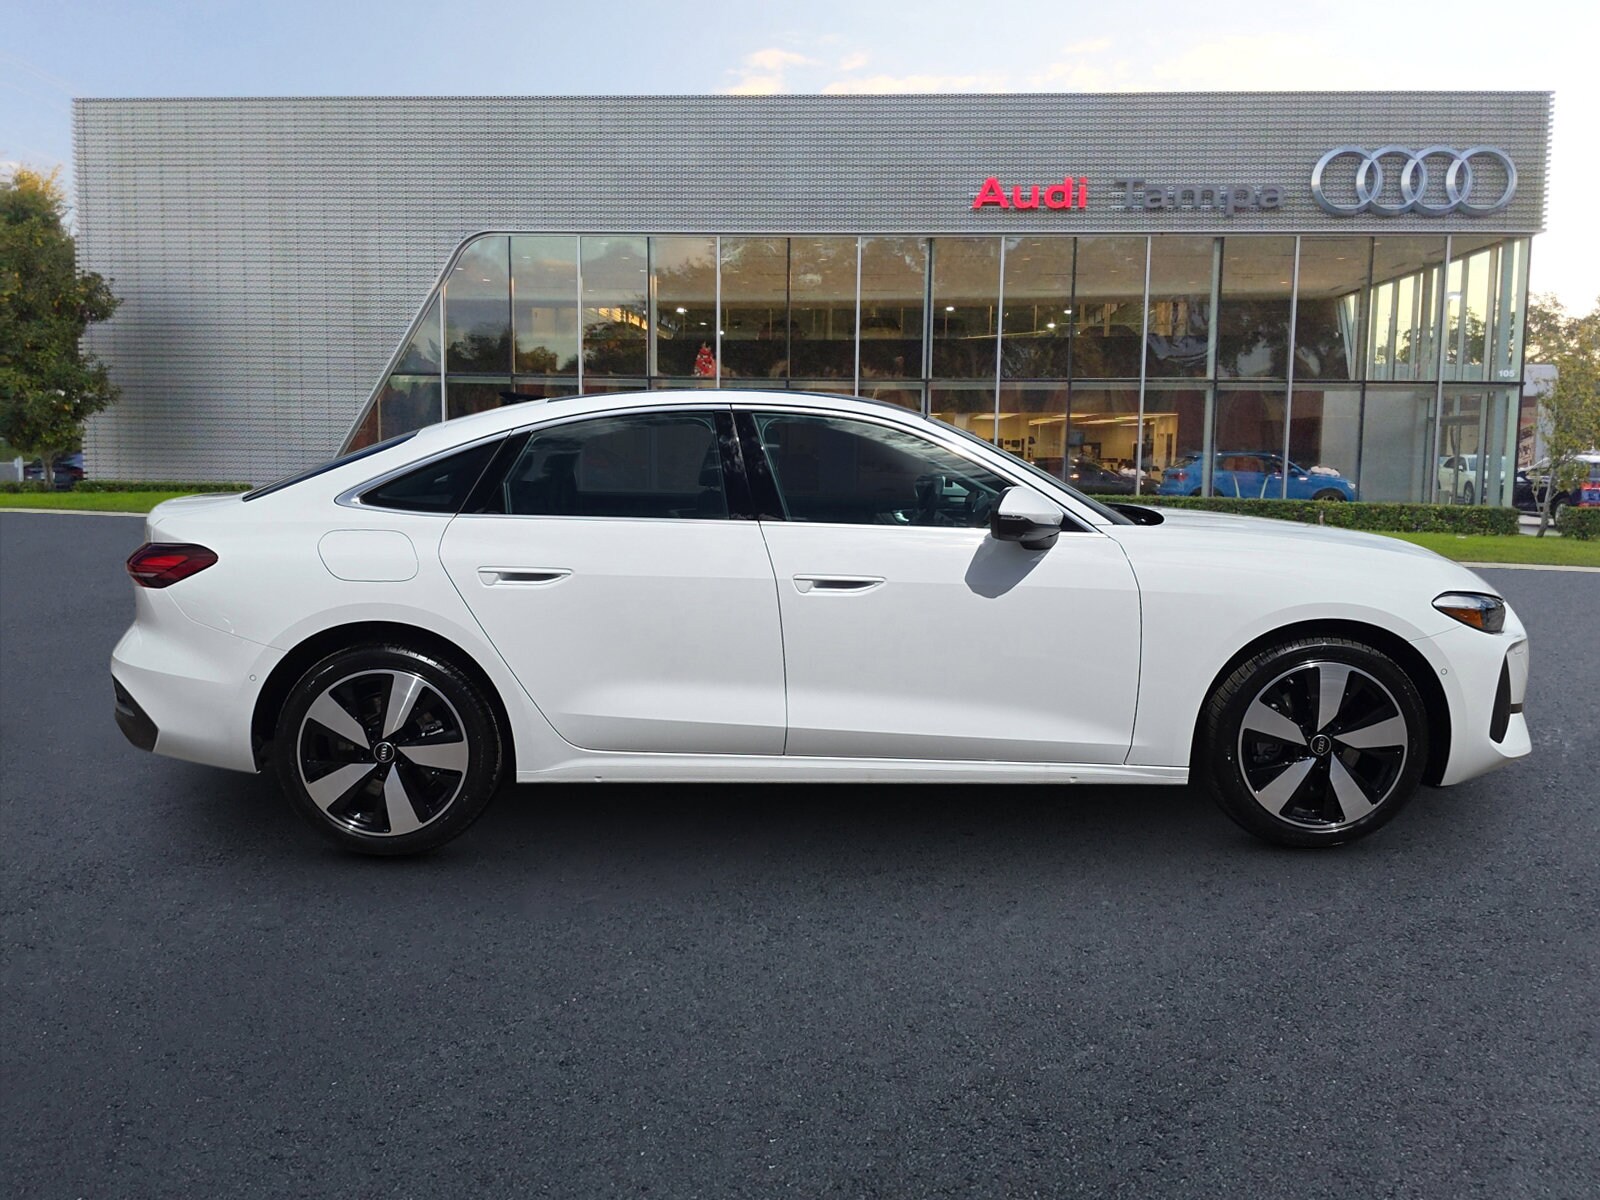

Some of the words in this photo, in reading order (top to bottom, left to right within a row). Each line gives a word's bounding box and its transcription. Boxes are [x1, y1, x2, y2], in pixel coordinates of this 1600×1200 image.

[972, 176, 1088, 209] Audi
[1114, 177, 1286, 217] Tampa
[1498, 369, 1516, 378] 105
